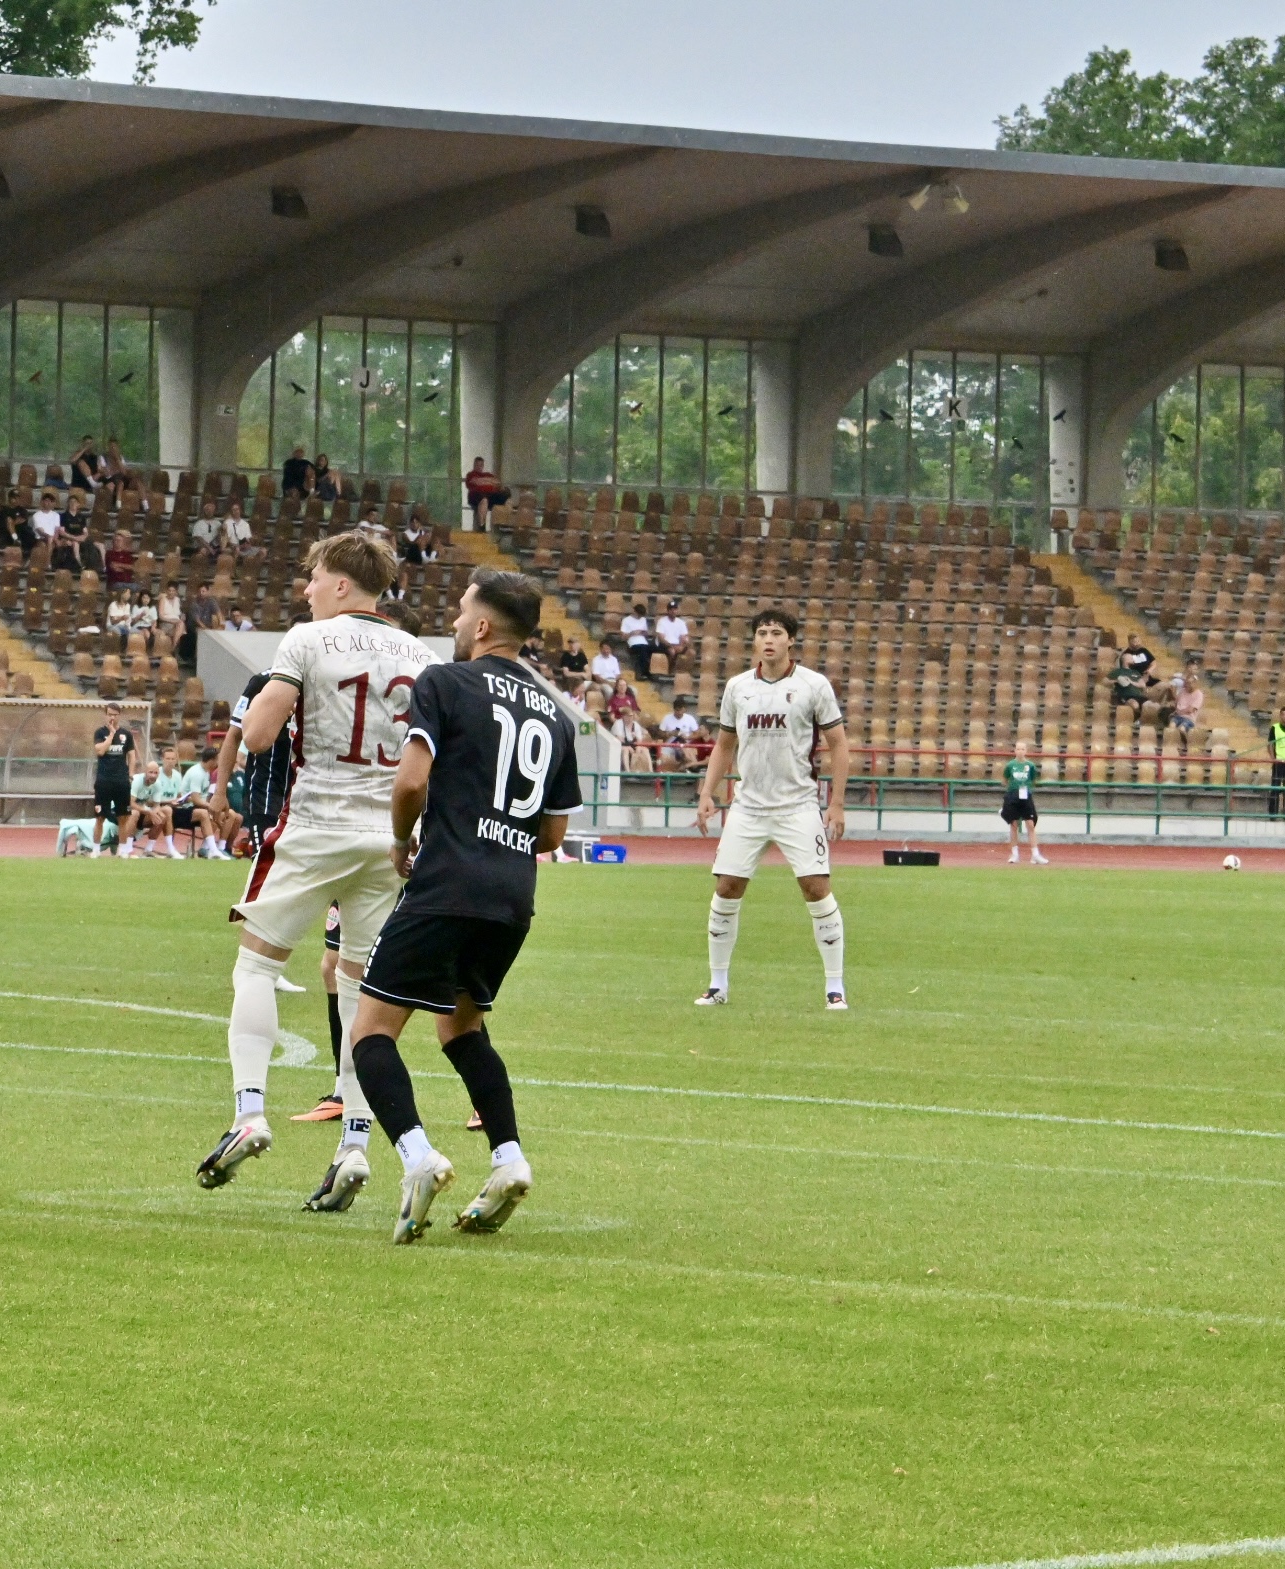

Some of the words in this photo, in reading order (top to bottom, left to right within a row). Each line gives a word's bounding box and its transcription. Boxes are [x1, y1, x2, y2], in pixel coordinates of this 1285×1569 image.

[359, 369, 370, 389] J
[948, 399, 962, 418] K
[322, 635, 346, 655] FC
[482, 672, 519, 703] TSV
[522, 687, 557, 722] 1882
[335, 671, 417, 768] 13
[747, 713, 788, 729] WWK
[492, 703, 553, 819] 19
[815, 834, 826, 857] 8
[818, 921, 840, 931] FCA
